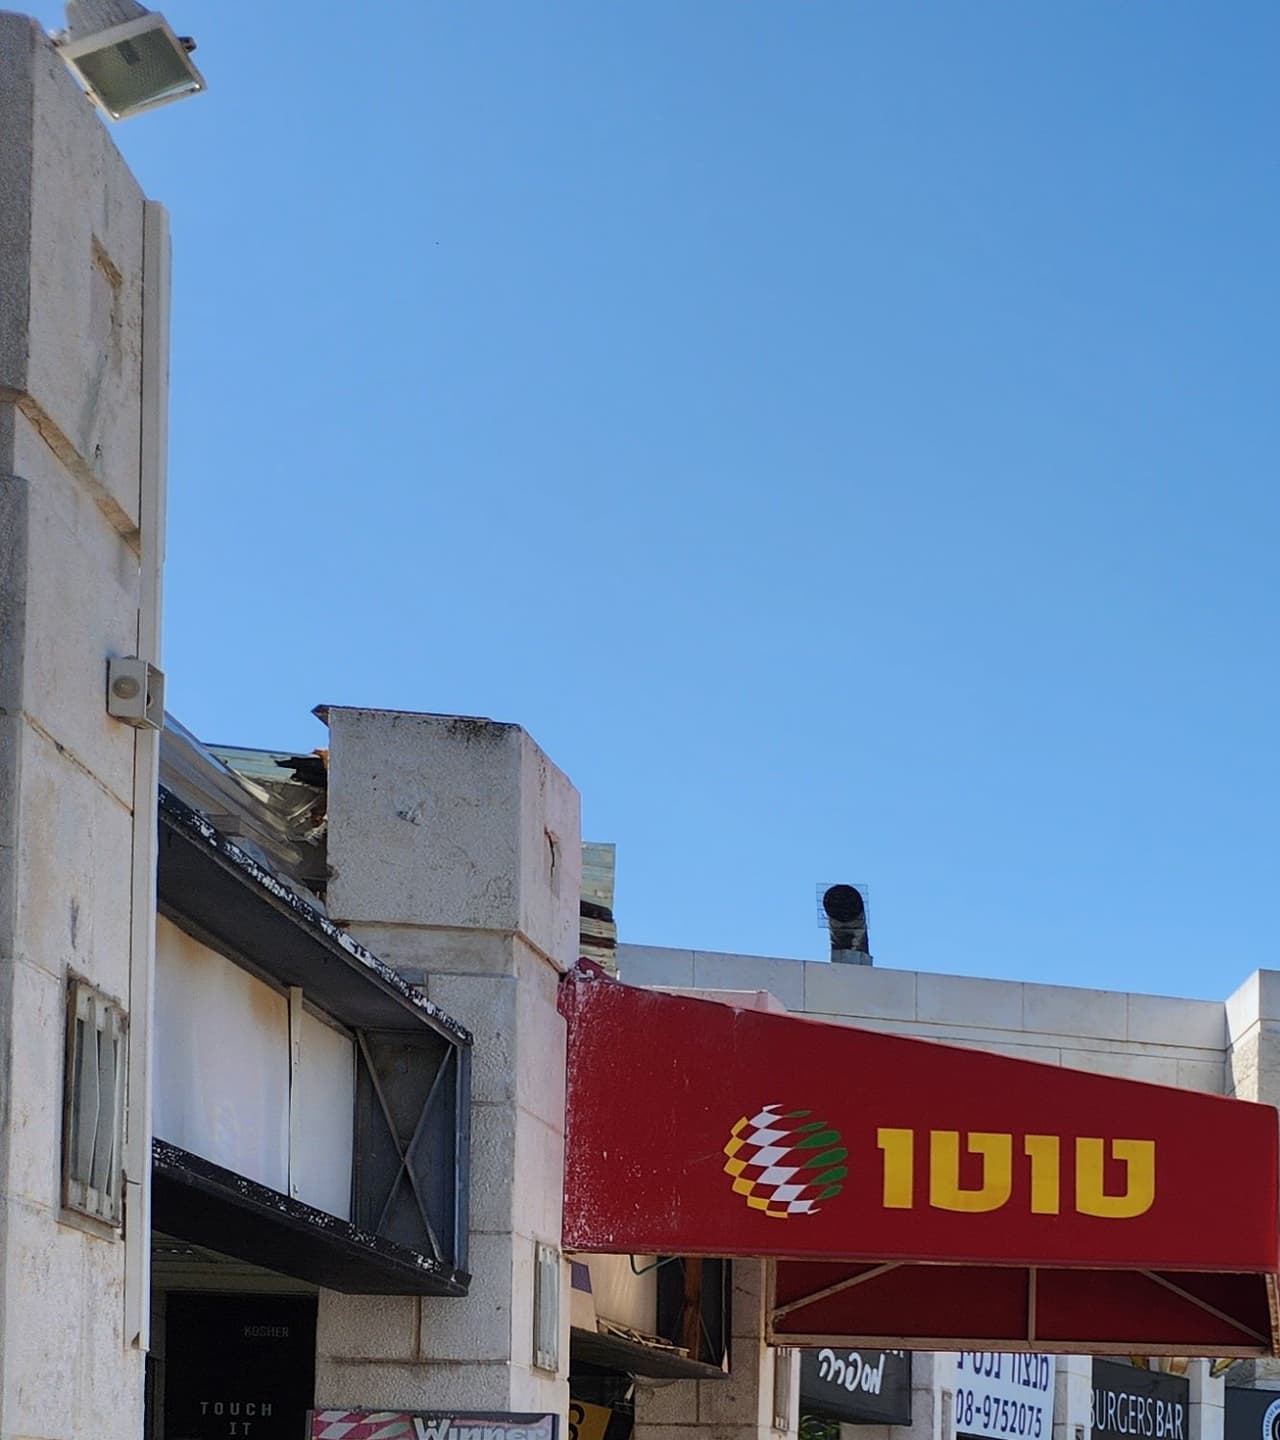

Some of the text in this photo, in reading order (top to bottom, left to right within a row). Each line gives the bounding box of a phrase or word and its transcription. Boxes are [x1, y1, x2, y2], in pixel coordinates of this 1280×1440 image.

[877, 1127, 1156, 1218] טוטו
[244, 1325, 289, 1337] KOSHER
[818, 1348, 885, 1395] מספרה
[200, 1401, 273, 1417] TOUCH
[229, 1421, 252, 1436] IT
[955, 1388, 1042, 1438] 08-9752075
[1156, 1400, 1184, 1440] BAR
